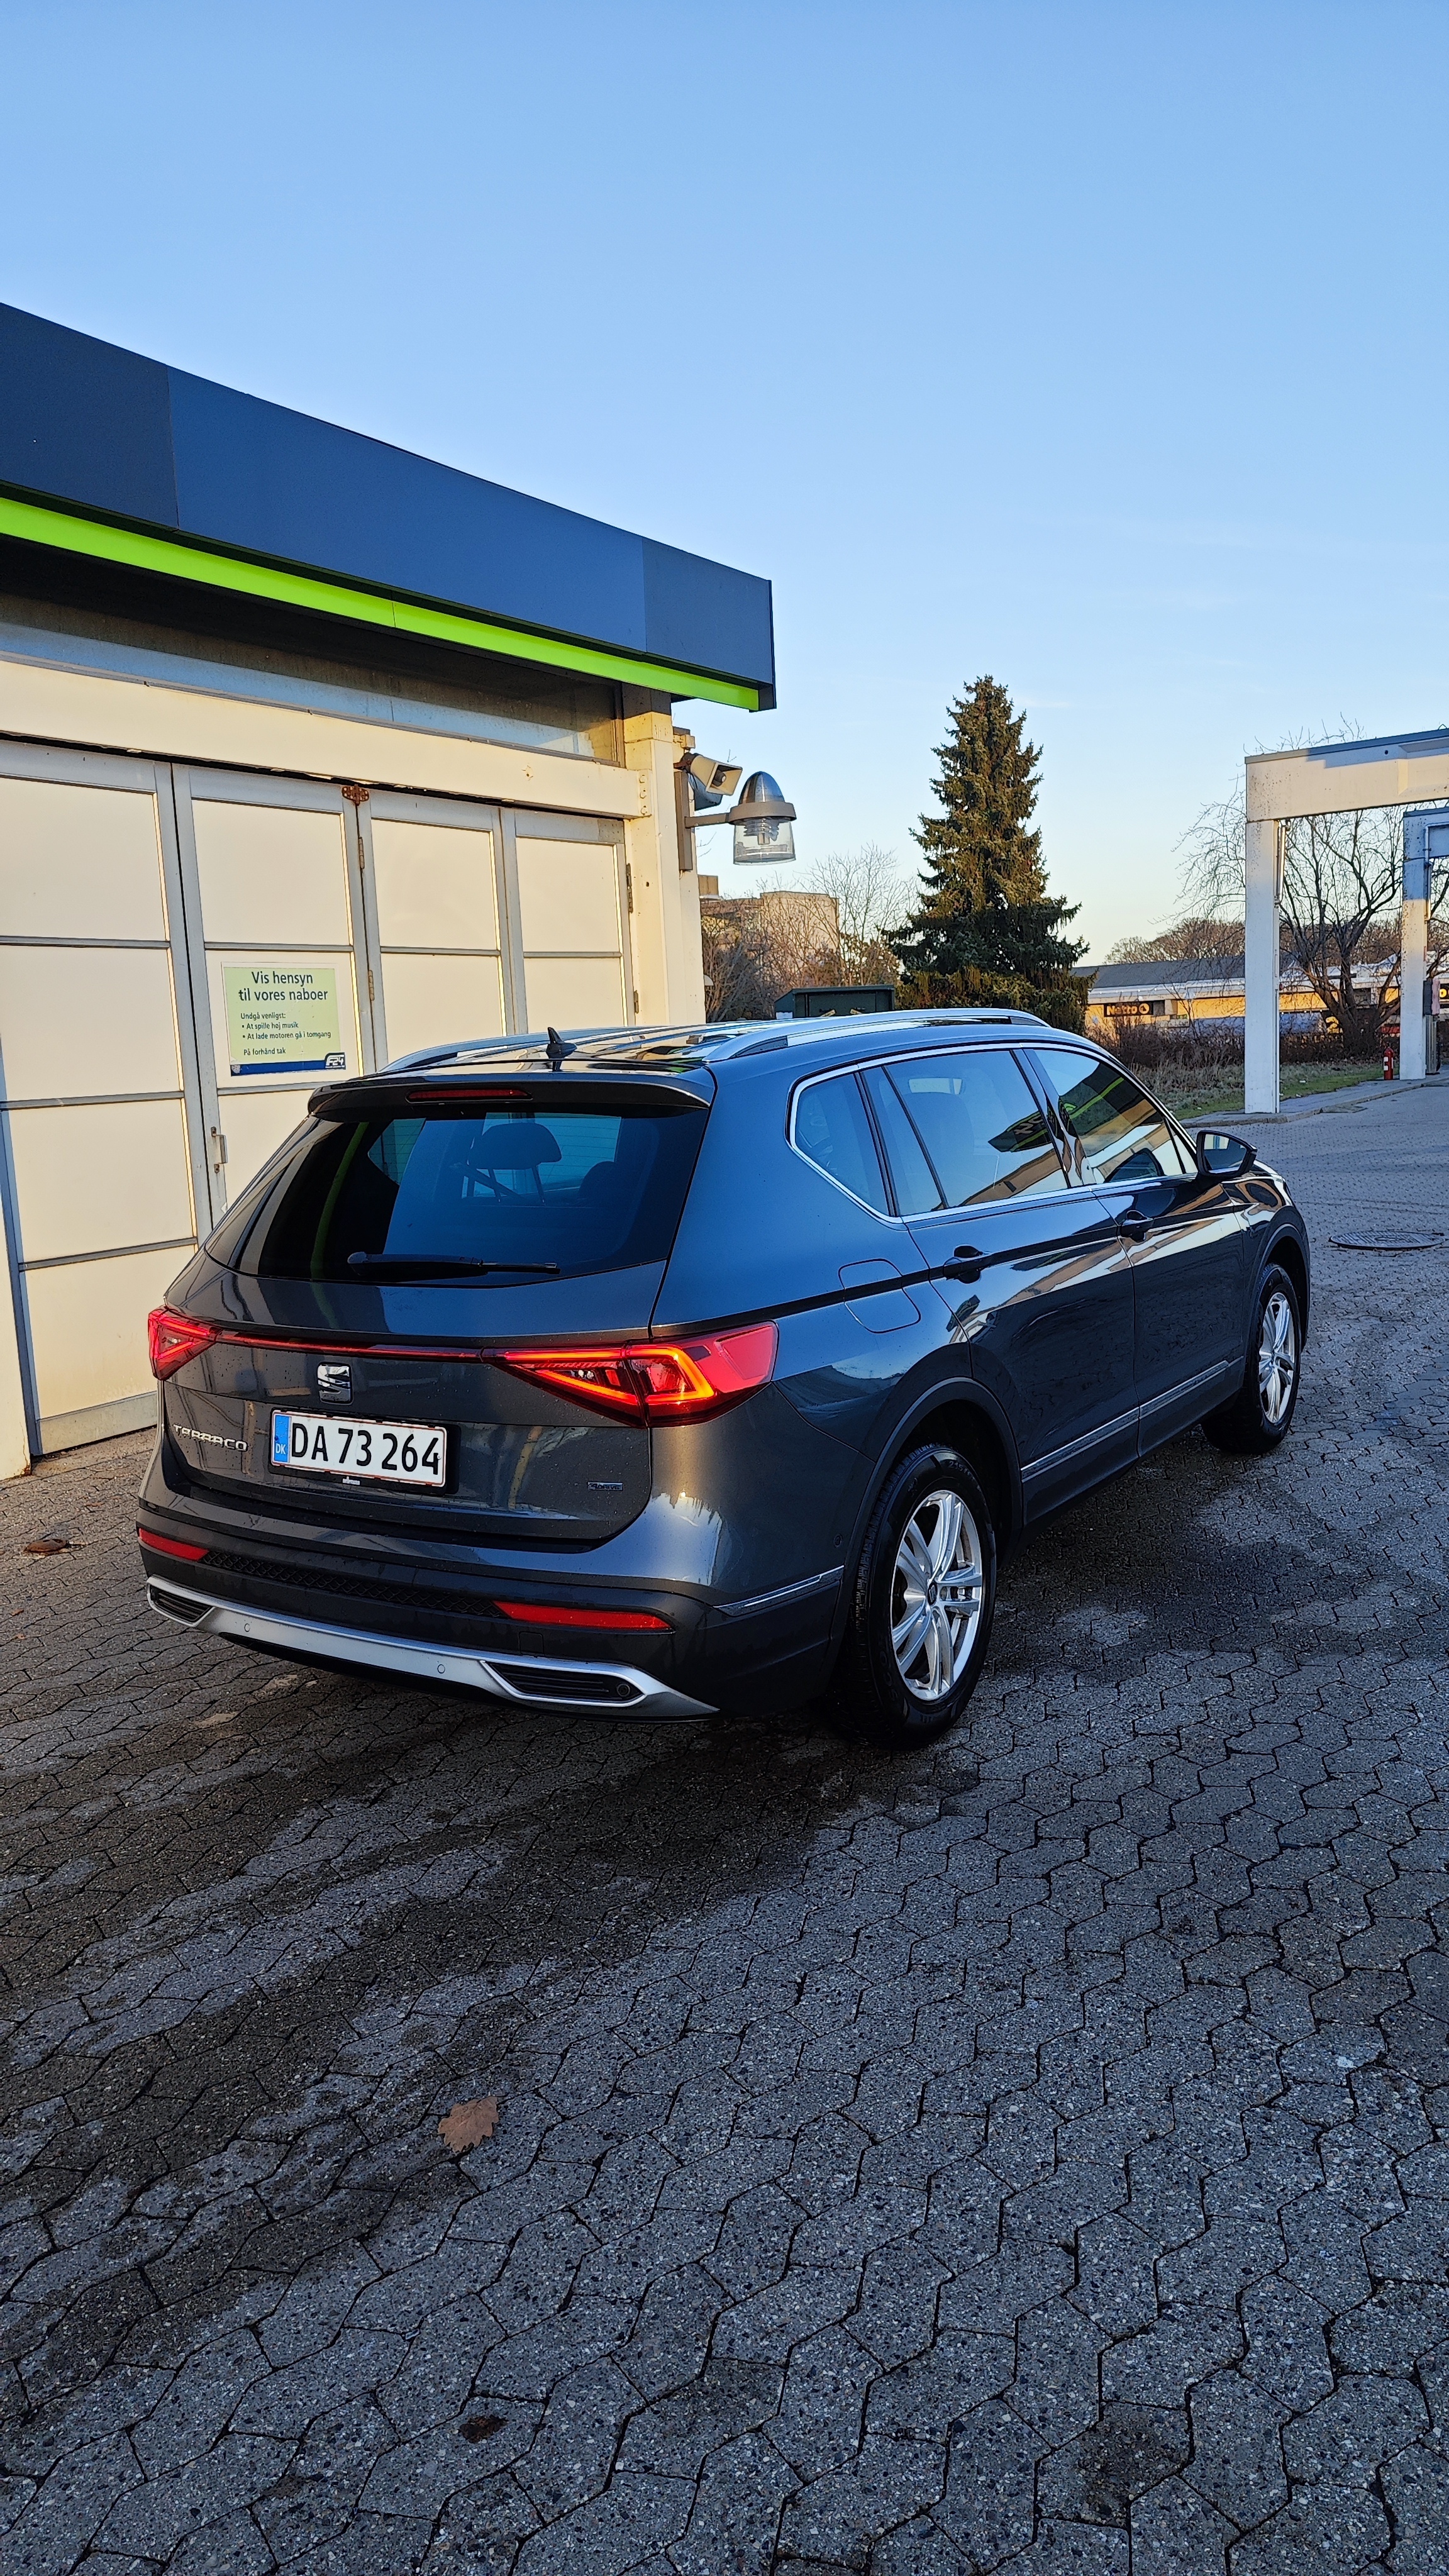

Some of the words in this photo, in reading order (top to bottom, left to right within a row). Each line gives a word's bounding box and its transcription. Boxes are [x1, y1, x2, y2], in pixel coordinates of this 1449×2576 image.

[251, 971, 270, 984] Vis
[273, 970, 313, 987] hensyn
[238, 988, 250, 1001] til
[254, 991, 286, 1001] vores
[289, 987, 328, 1000] naboer
[1107, 1005, 1138, 1016] Netto
[240, 1012, 260, 1021] Undgå
[262, 1012, 286, 1020] venligst:
[255, 1023, 270, 1031] spille
[295, 1031, 303, 1040] gå
[326, 1055, 344, 1066] F24
[173, 1424, 248, 1451] TARRACO
[275, 1443, 286, 1455] DK
[292, 1423, 328, 1461] DA
[338, 1428, 372, 1467] 73
[382, 1433, 438, 1475] 264
